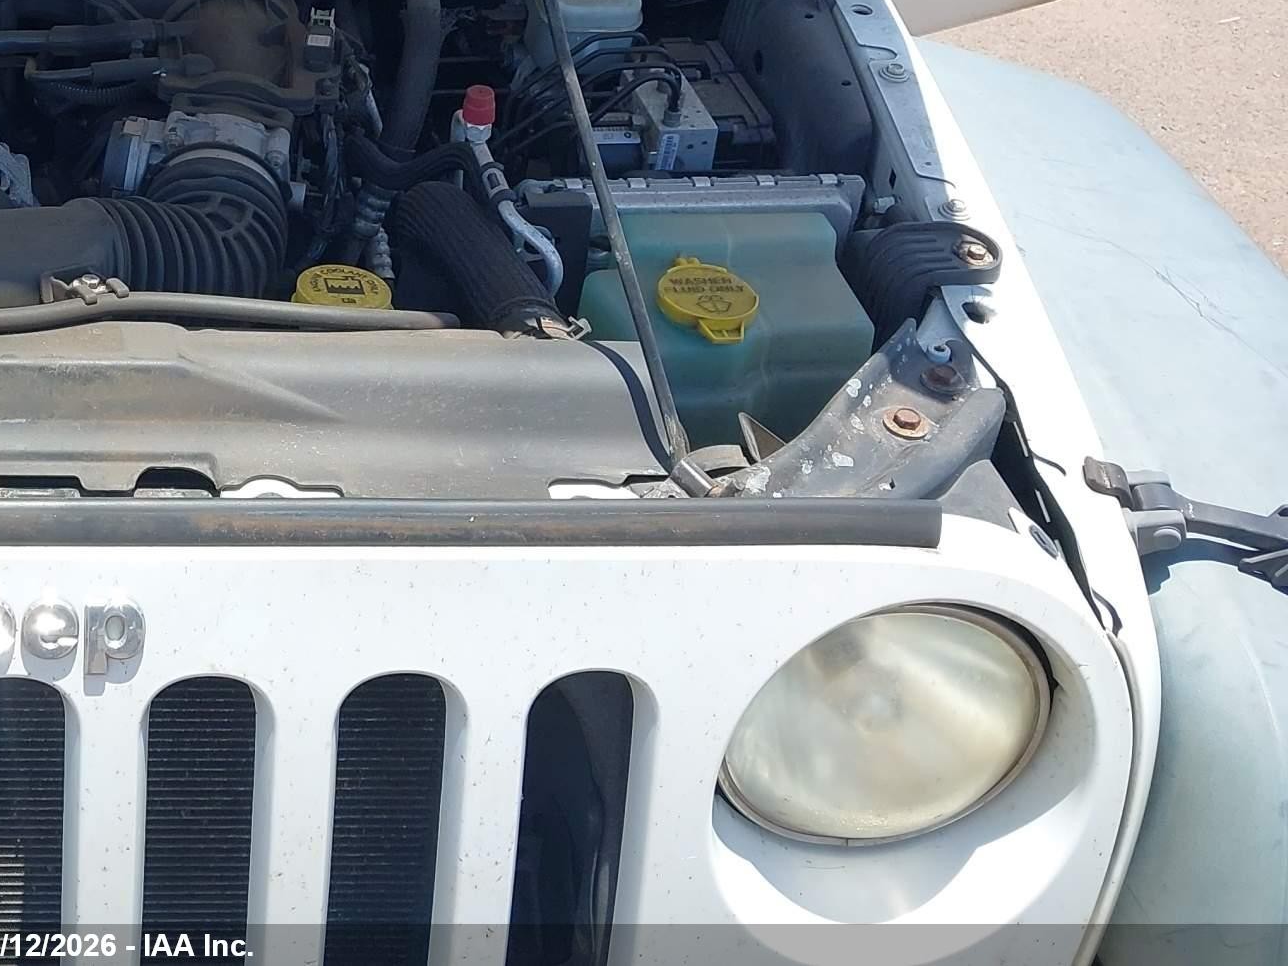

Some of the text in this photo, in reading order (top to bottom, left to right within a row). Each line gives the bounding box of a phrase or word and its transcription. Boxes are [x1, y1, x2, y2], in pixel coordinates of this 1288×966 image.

[320, 268, 367, 280] COOLANT
[668, 277, 732, 285] WASHER
[710, 285, 744, 293] ONLY
